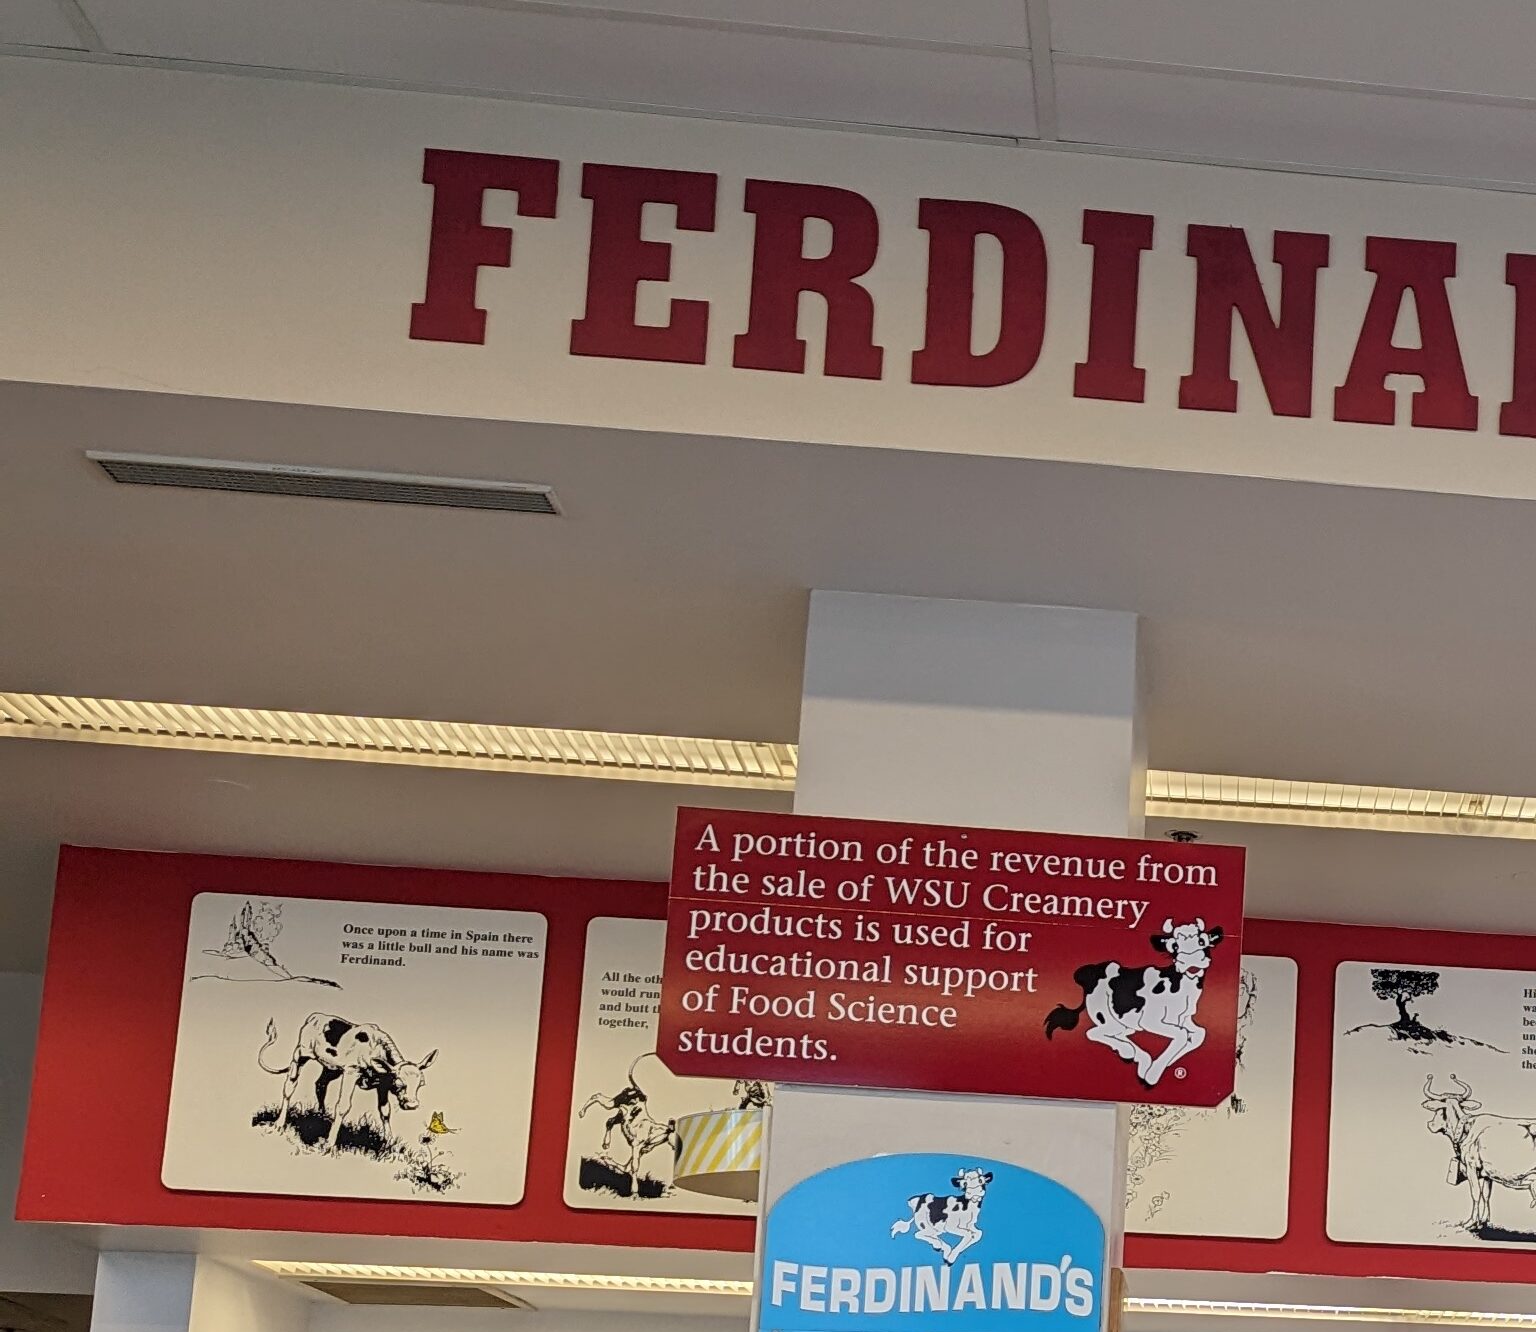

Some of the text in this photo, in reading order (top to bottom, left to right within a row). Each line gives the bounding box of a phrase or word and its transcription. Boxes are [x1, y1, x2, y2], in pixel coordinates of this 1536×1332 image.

[695, 824, 1218, 886] A portion of the revenue from
[693, 864, 1150, 928] the sale of WSU Creamery
[343, 924, 374, 935] Once
[377, 928, 407, 938] upon
[421, 929, 447, 939] time
[450, 931, 462, 940] in
[465, 931, 499, 943] Spain
[503, 933, 533, 944] there
[687, 907, 1032, 952] products is used for
[340, 954, 405, 967] Ferdinand.
[342, 941, 539, 959] was a little bull and his name was
[602, 972, 620, 981] All
[623, 973, 641, 983] the
[686, 948, 1038, 997] educational support
[601, 988, 636, 997] would
[683, 985, 958, 1027] of Food Science
[599, 1002, 621, 1011] and
[625, 1003, 648, 1013] butt
[598, 1017, 648, 1029] together,
[678, 1027, 838, 1061] students.
[771, 1255, 1094, 1317] FERDINAND'S
